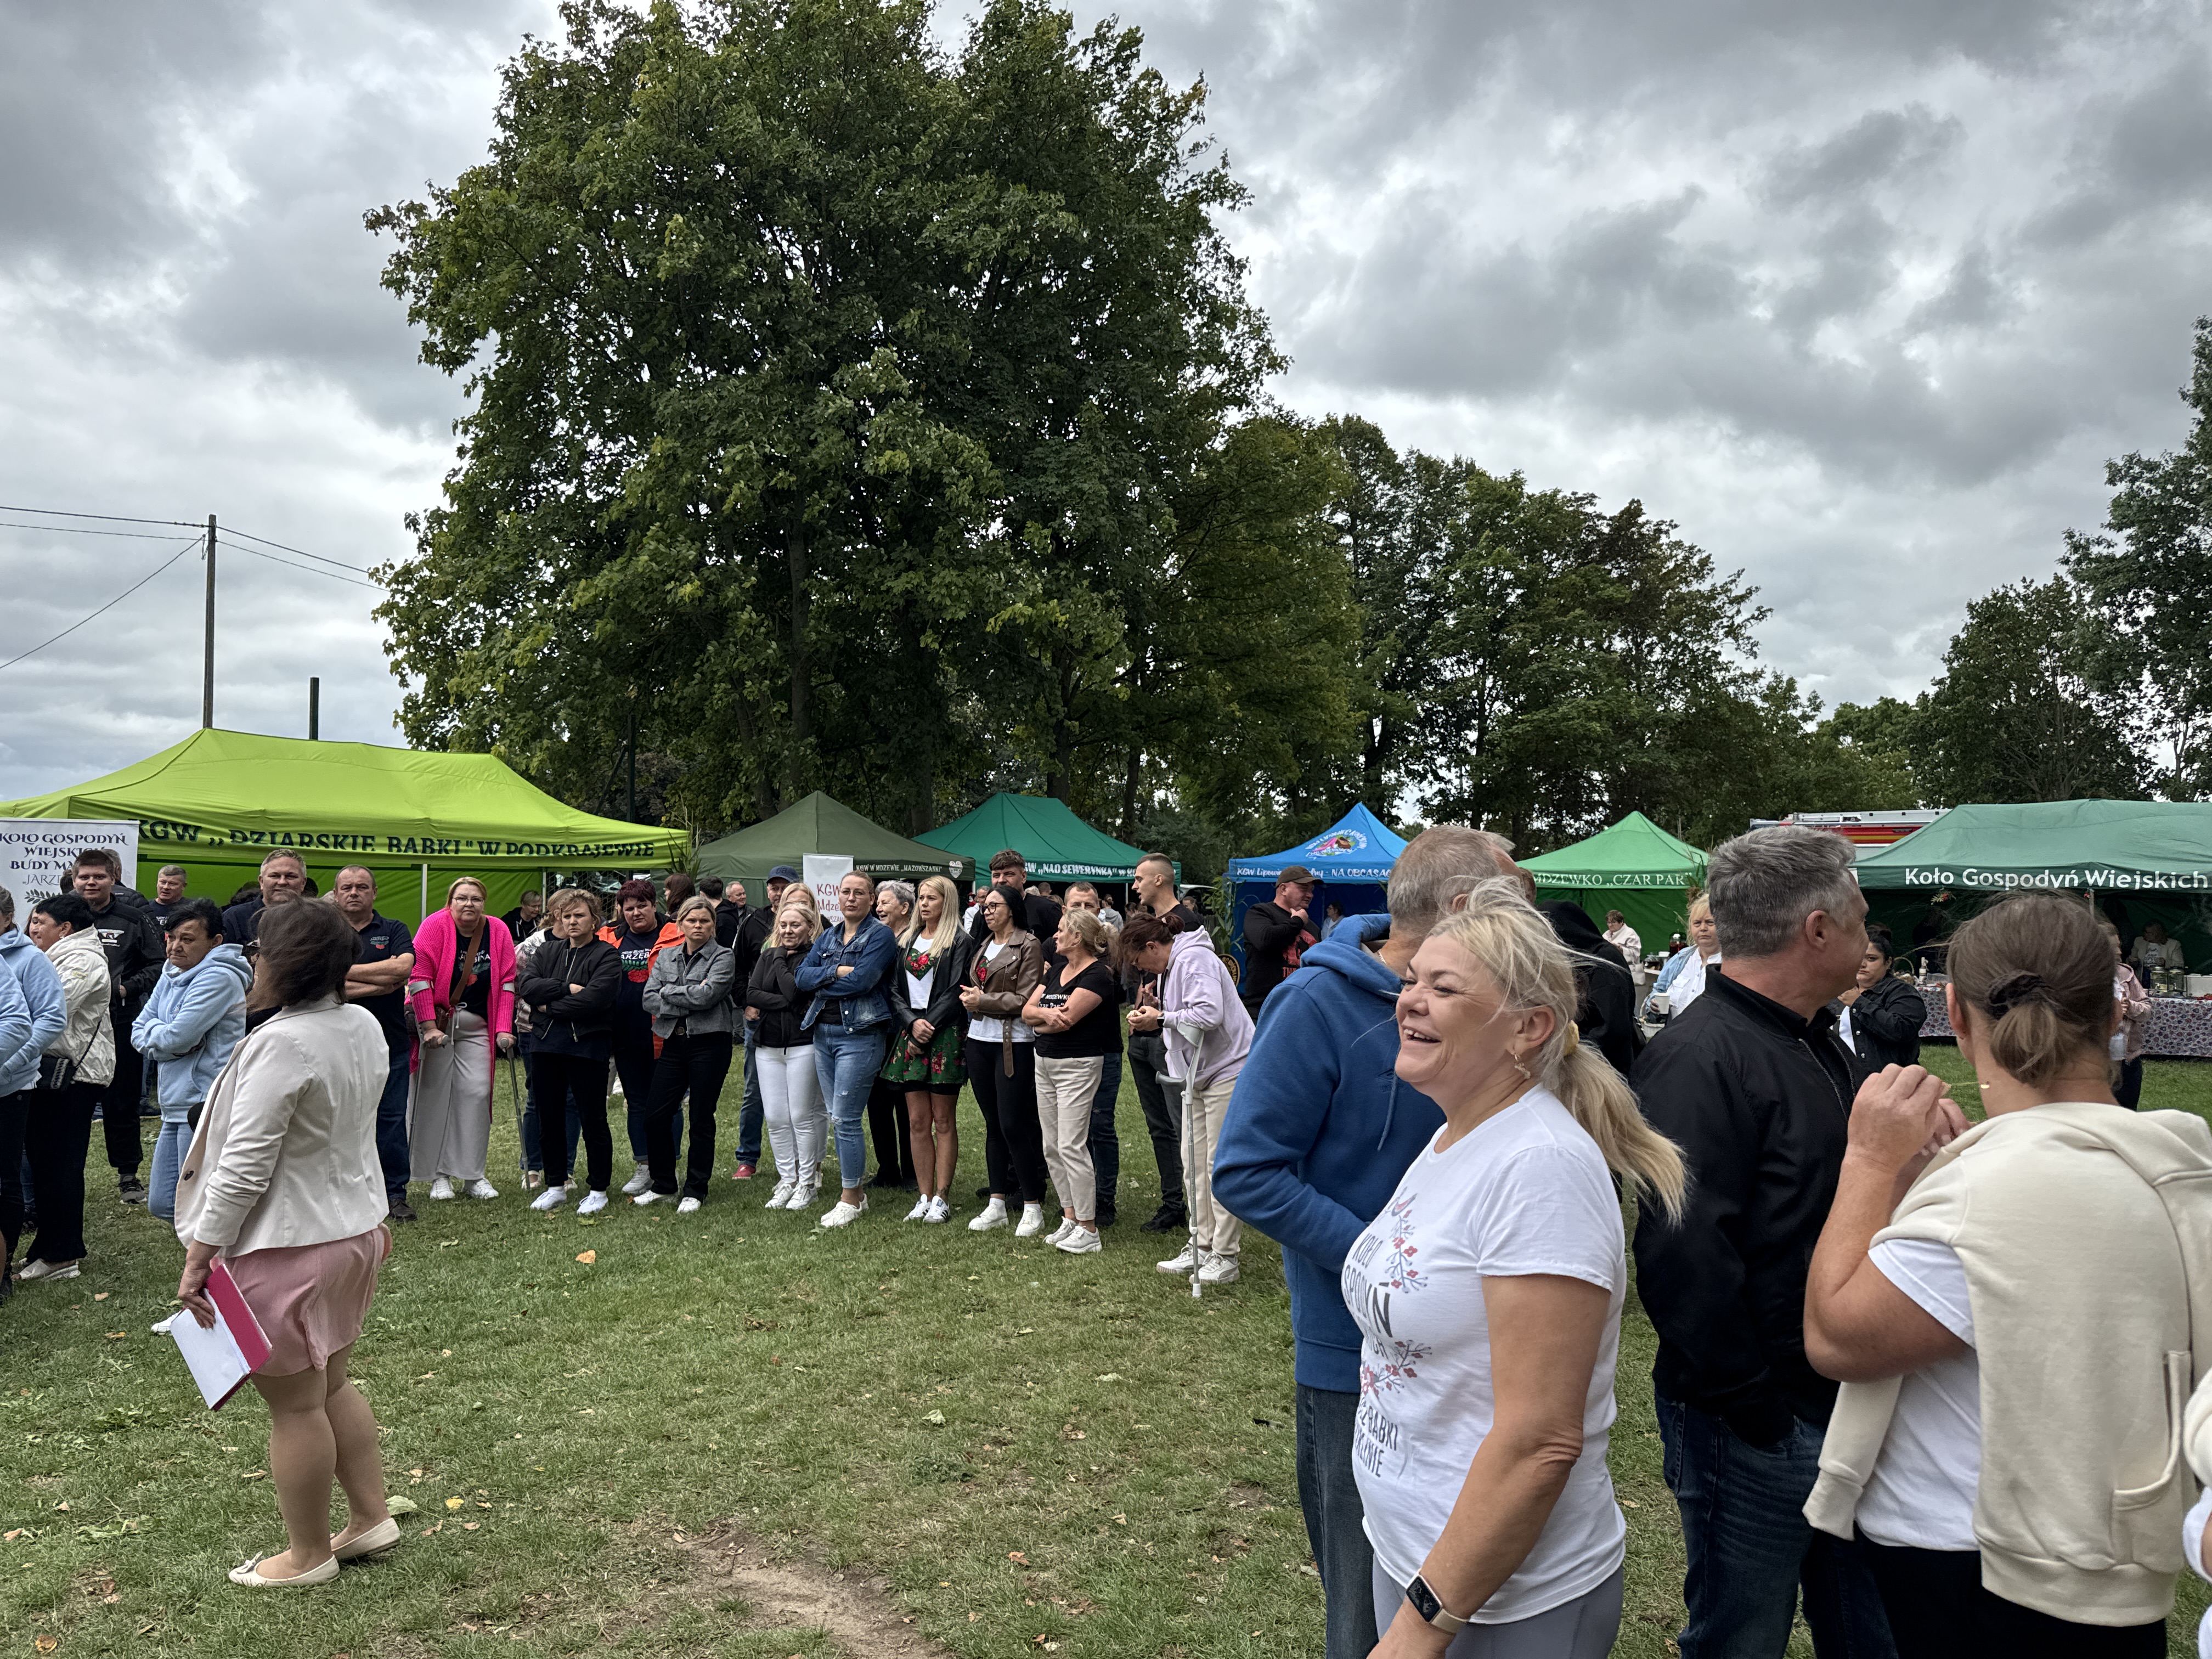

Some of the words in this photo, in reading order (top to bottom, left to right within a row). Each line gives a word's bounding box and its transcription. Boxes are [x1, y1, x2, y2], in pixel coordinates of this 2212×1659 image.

[0, 833, 39, 845] KOŁO
[42, 833, 129, 845] GOSPODYŃ
[139, 820, 203, 842] KGW
[477, 841, 501, 855] W
[505, 842, 654, 859] PODKRAJEWIE
[24, 844, 105, 858] WIEJSKI
[9, 859, 53, 870] BUDY
[1237, 867, 1255, 876] KGW
[1331, 868, 1345, 877] NA
[1347, 868, 1391, 878] OBCASAC
[1905, 867, 1955, 885] Koło
[1962, 868, 2079, 890] Gospodyń
[2084, 870, 2209, 890] Wiejskich
[1533, 873, 1602, 885] MDZEWKO
[1606, 874, 1652, 887] „CZAR
[817, 899, 840, 912] Mdze
[1352, 1233, 1383, 1269] KOŁO
[1344, 1264, 1393, 1338] SPODYŃ
